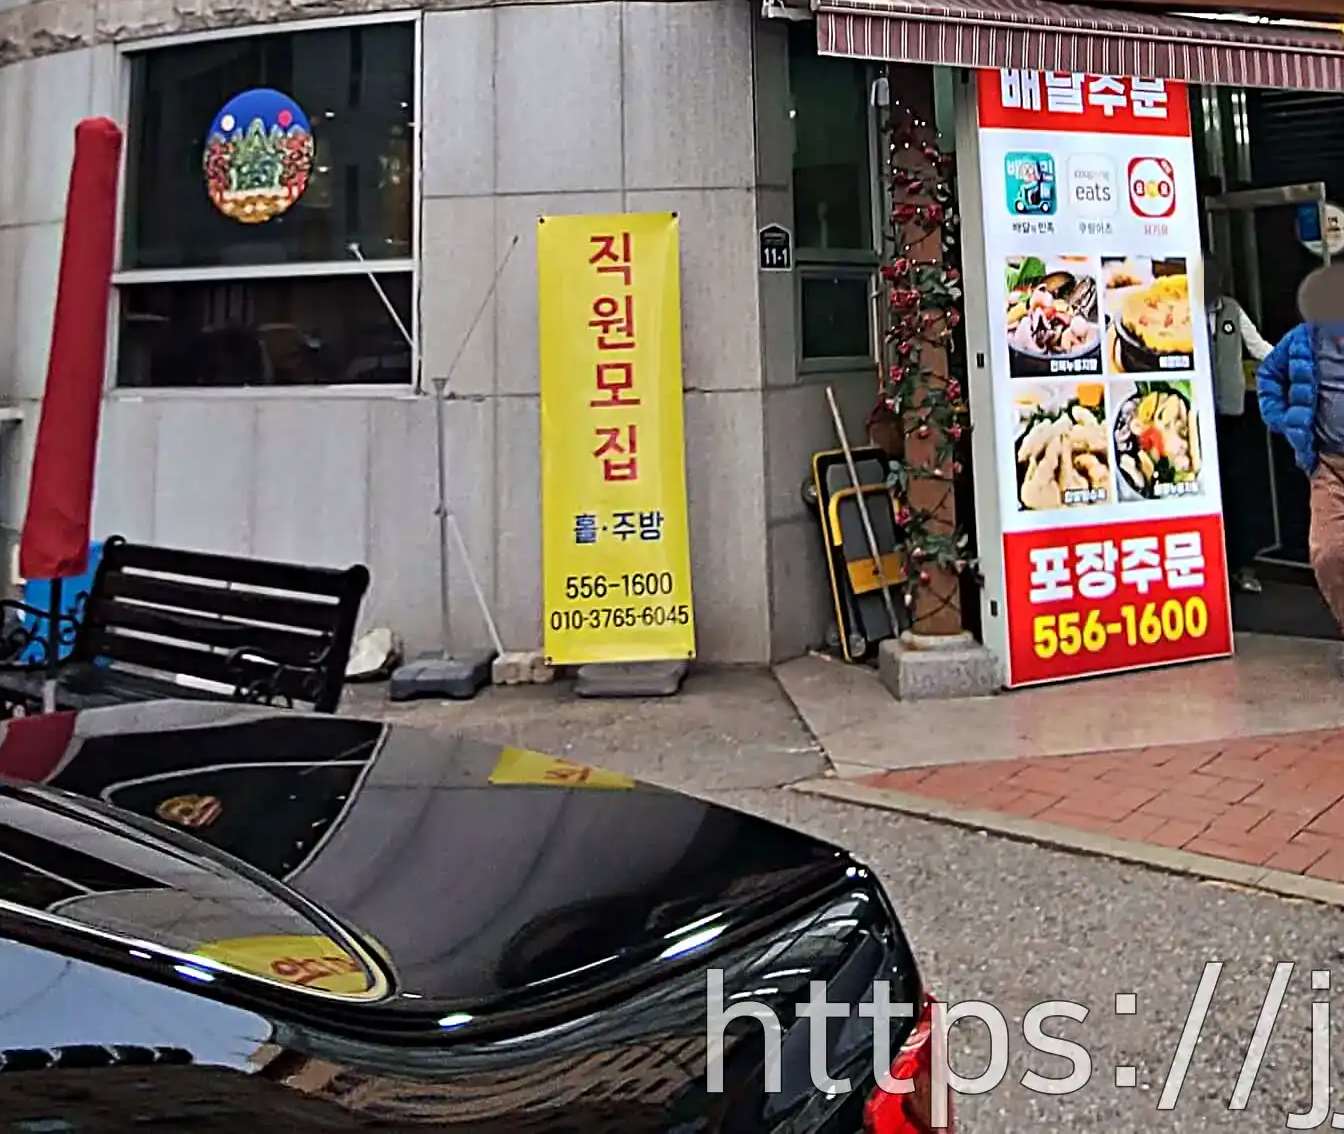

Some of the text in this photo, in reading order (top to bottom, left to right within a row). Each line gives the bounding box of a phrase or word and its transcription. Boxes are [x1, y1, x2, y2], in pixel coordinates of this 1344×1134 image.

[1000, 69, 1168, 118] 배달주문
[1075, 184, 1111, 202] eats
[588, 232, 641, 483] 직원모집
[565, 571, 673, 600] 556-1600
[1029, 531, 1205, 604] 포장주문
[551, 604, 690, 631] 010-3765-6045
[1033, 597, 1209, 660] 556-1600
